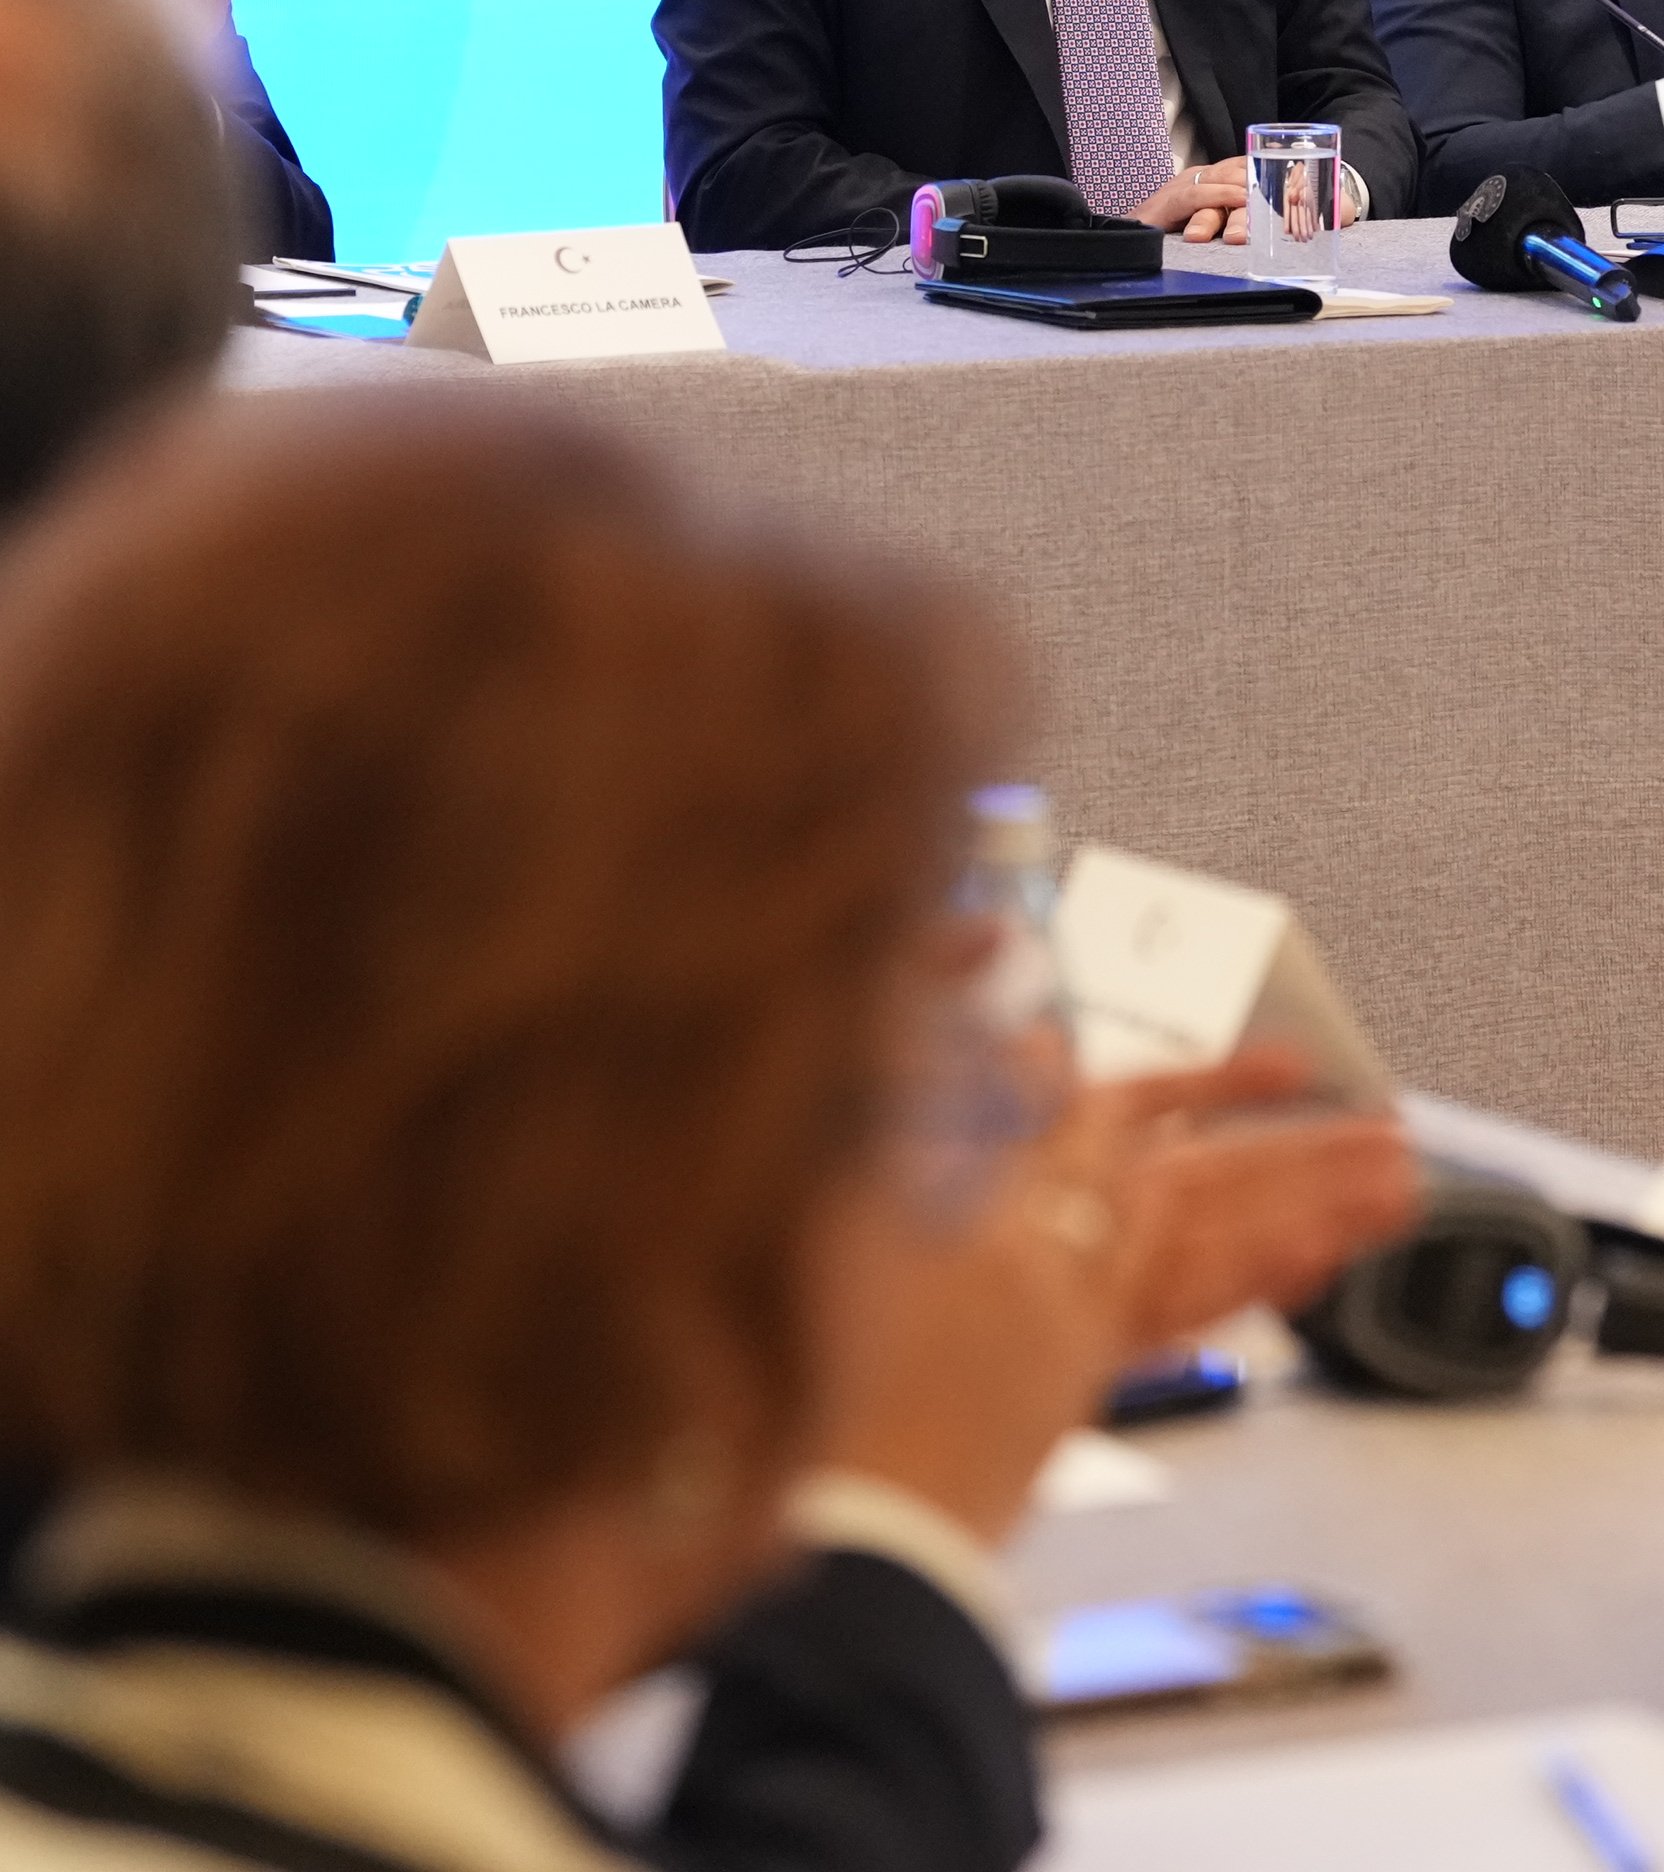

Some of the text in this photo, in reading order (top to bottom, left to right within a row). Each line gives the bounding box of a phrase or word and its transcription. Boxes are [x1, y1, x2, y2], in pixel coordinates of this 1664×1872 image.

[498, 296, 682, 319] FRANCESCO LA CAMERA
